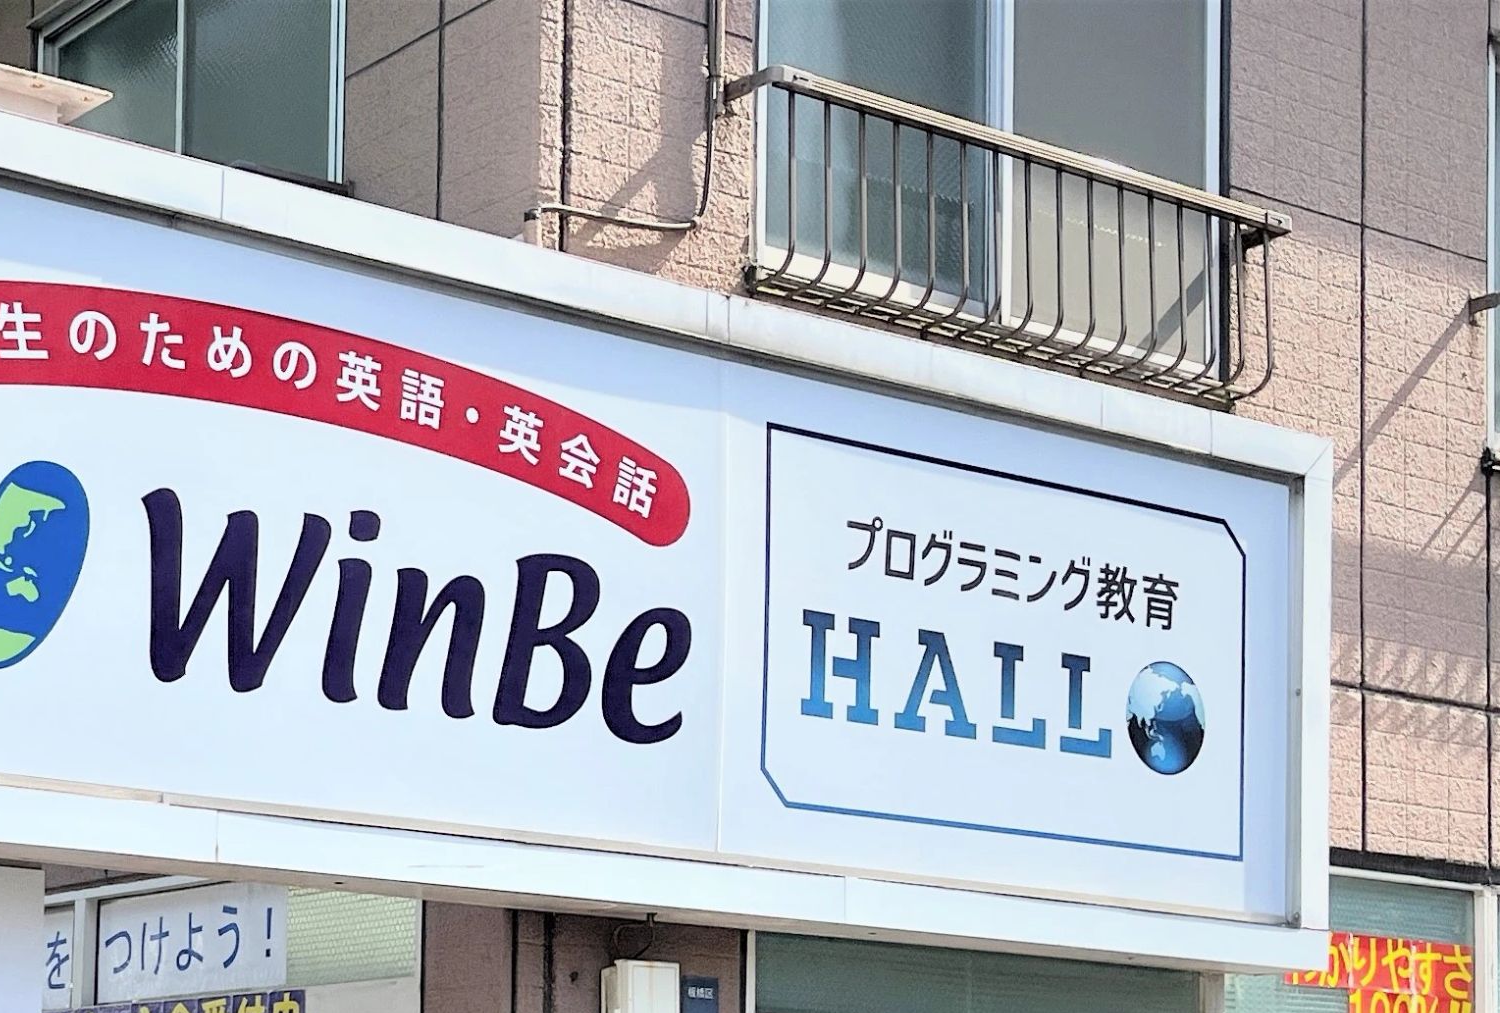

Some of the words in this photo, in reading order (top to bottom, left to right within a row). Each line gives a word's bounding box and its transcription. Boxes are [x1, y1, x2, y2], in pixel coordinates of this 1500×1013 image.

[141, 487, 694, 745] WinBe
[845, 515, 1181, 632] プログラミング教育
[1292, 932, 1473, 999] かりやすさ
